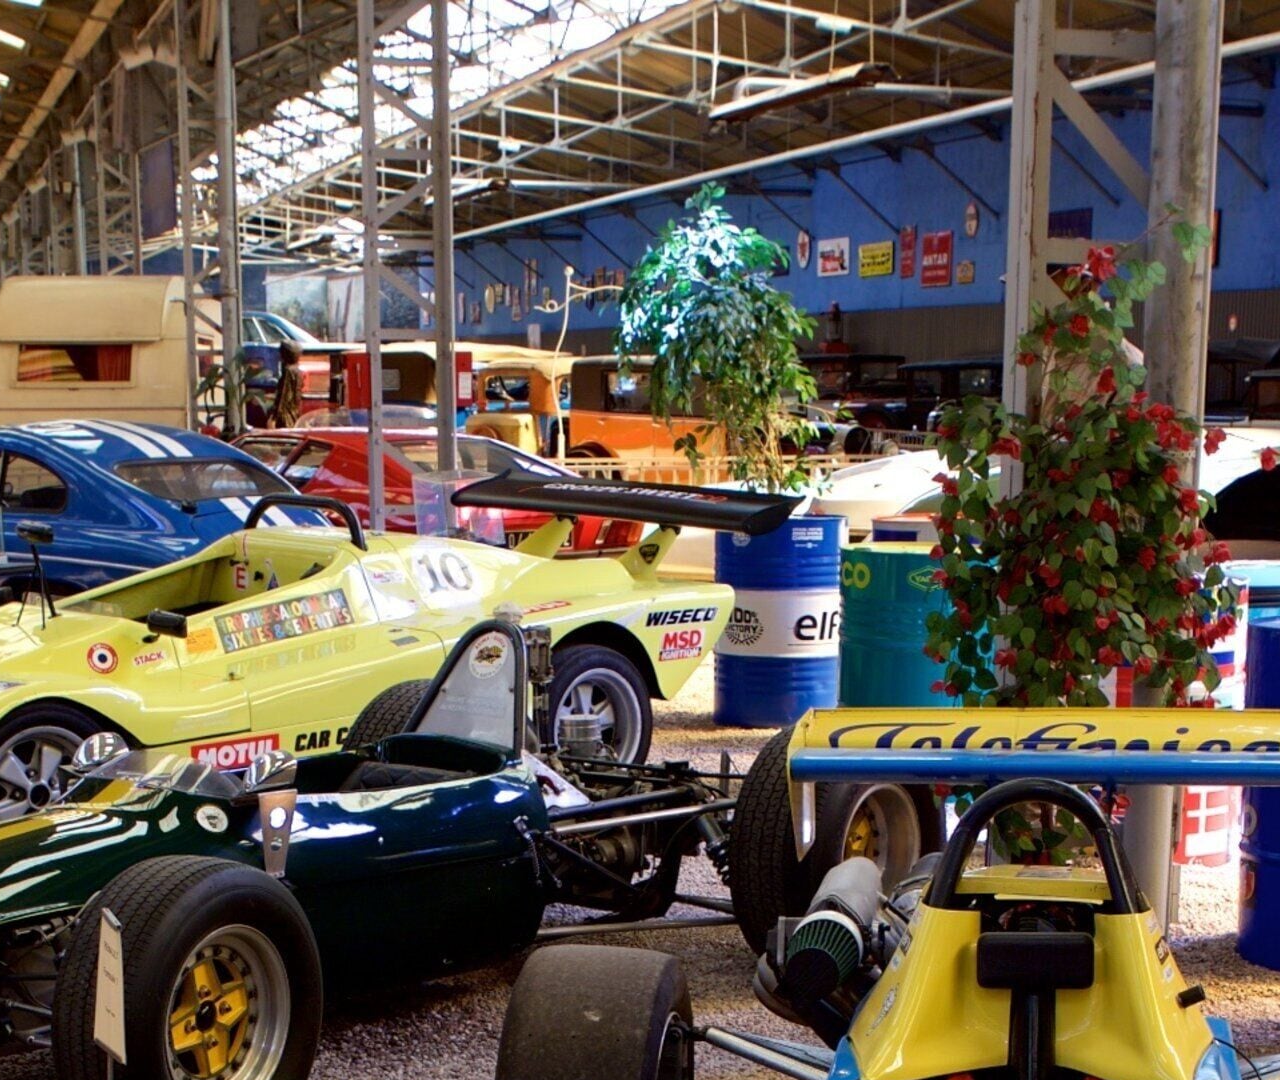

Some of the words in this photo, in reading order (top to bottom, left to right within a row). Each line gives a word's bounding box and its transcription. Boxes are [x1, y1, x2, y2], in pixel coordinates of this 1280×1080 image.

[416, 552, 473, 593] 10
[646, 606, 718, 627] WISECO
[794, 611, 839, 641] elf
[223, 626, 274, 651] SIXTIES
[274, 623, 285, 639] &
[286, 607, 352, 637] SEVENTIES
[662, 629, 702, 649] MSD
[134, 651, 165, 667] STACK
[660, 648, 701, 661] IGNITION
[294, 730, 331, 752] CAR
[197, 738, 275, 768] MOTUL
